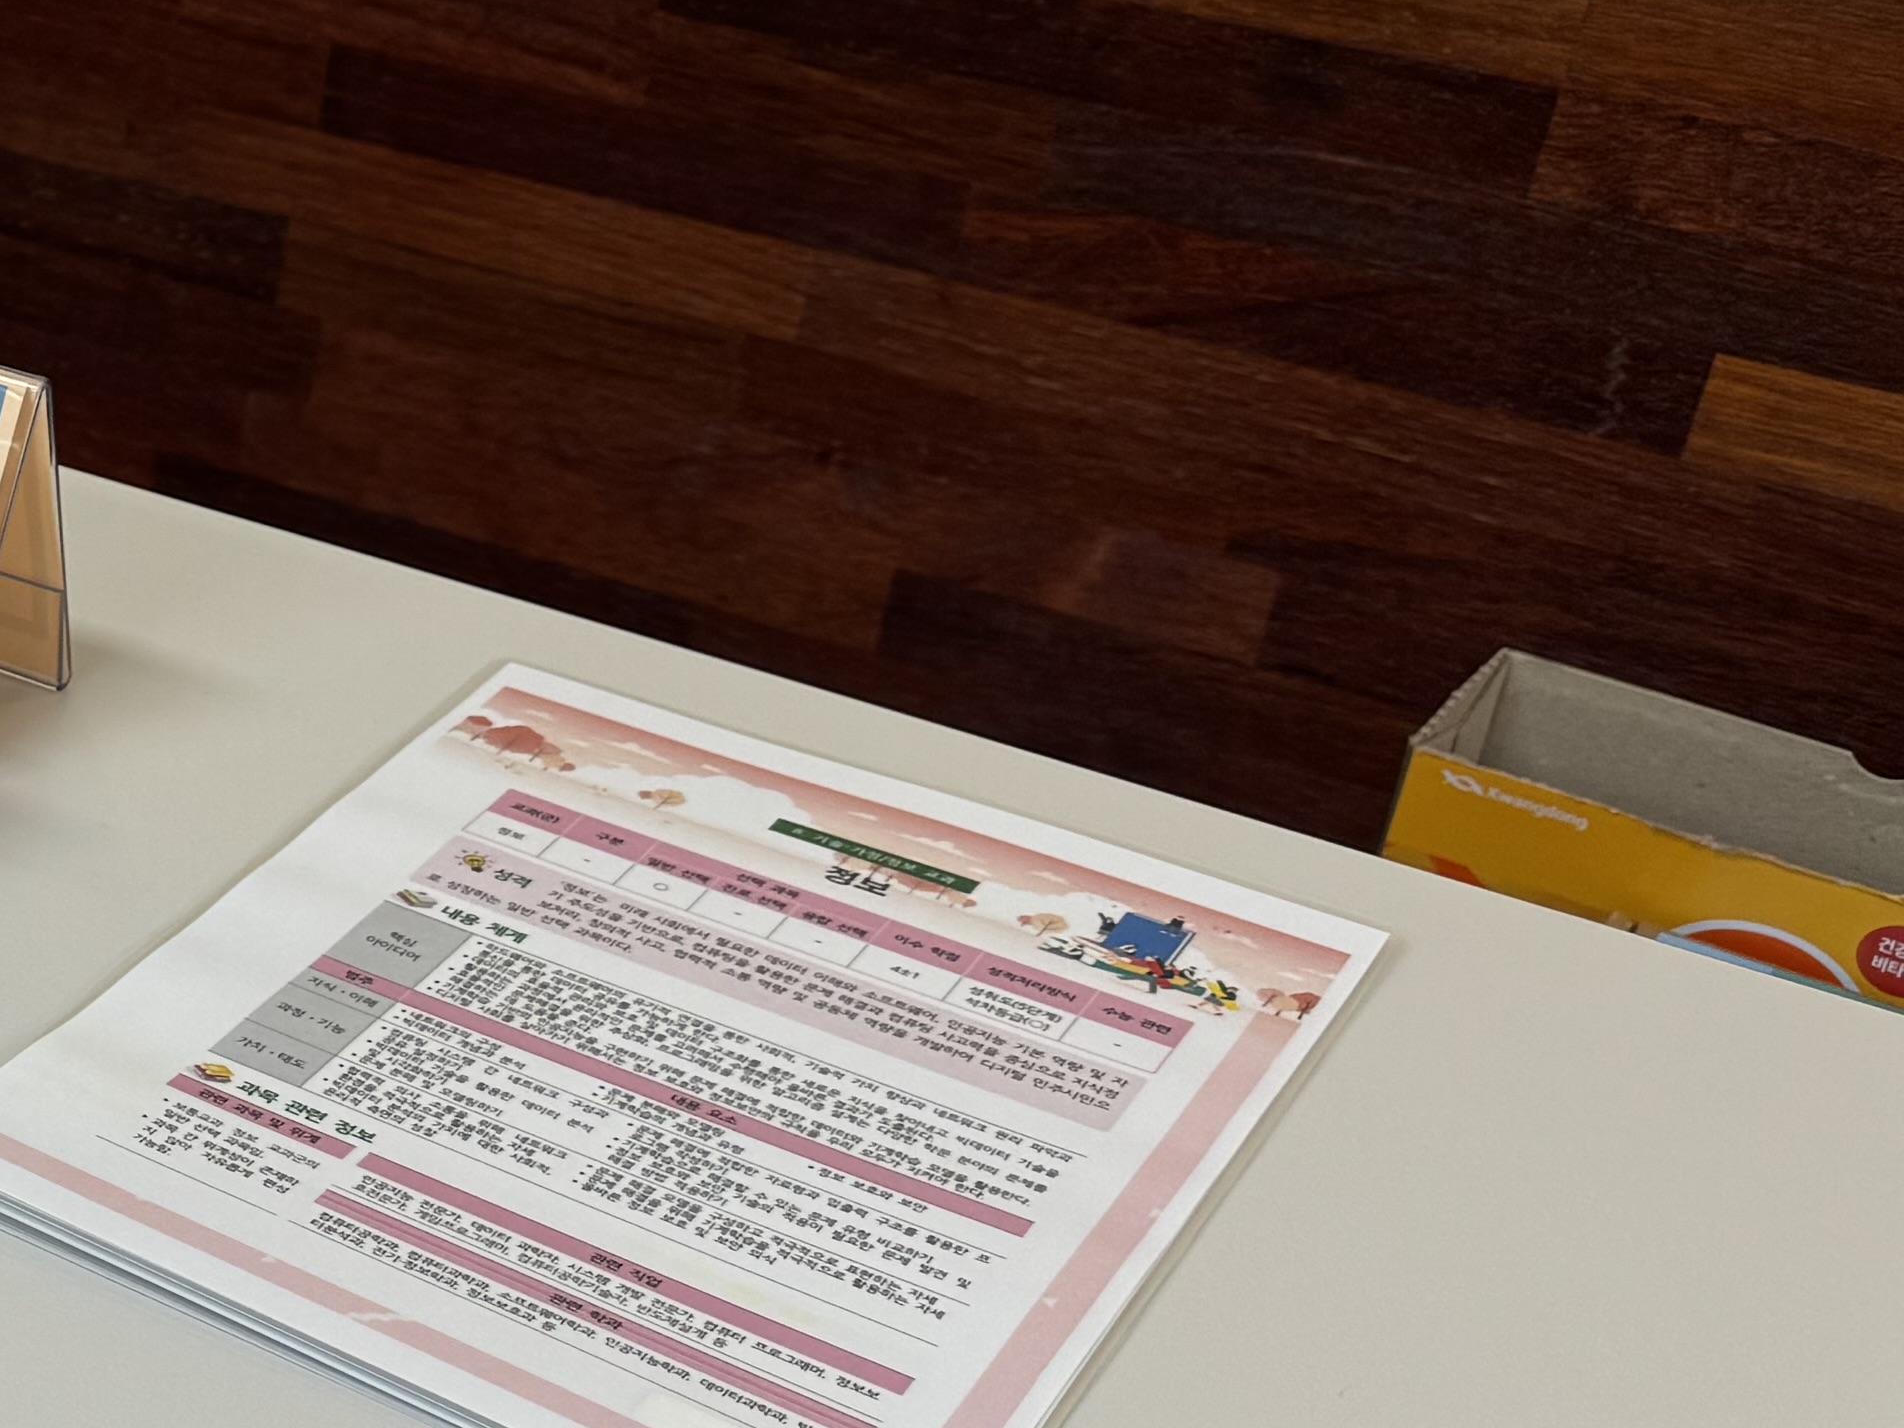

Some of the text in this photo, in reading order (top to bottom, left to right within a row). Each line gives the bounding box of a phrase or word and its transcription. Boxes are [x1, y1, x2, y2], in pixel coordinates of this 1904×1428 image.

[492, 868, 533, 889] 성격
[824, 864, 891, 897] 정보
[439, 904, 529, 945] 내용 체계
[235, 1080, 377, 1144] 과목 관련 정보
[588, 1251, 664, 1289] 관련 직업
